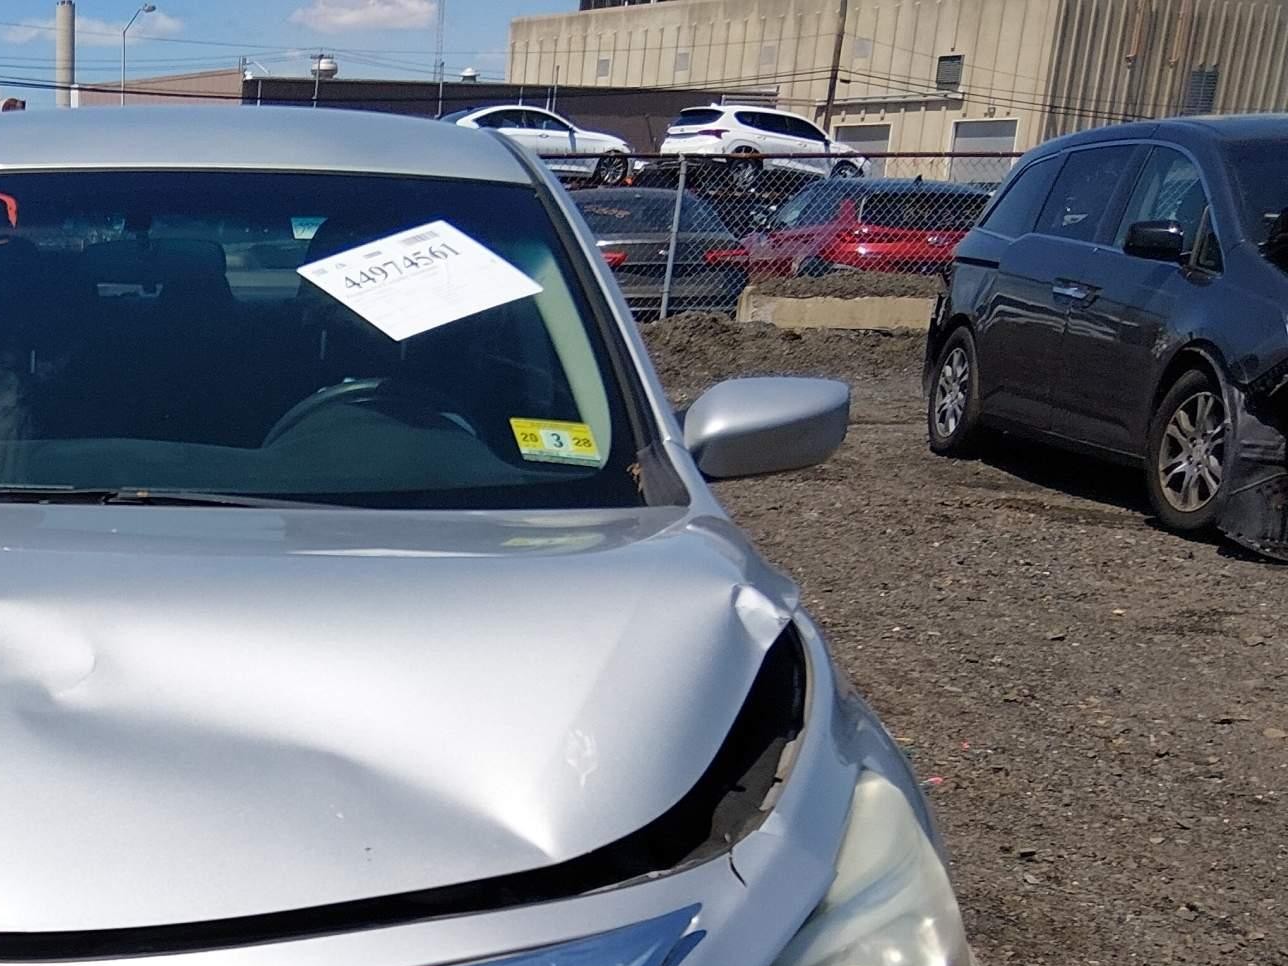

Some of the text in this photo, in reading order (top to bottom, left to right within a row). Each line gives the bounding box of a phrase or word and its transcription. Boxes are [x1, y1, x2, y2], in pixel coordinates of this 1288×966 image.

[344, 242, 462, 289] 44974561
[519, 432, 592, 449] 20 3 28
